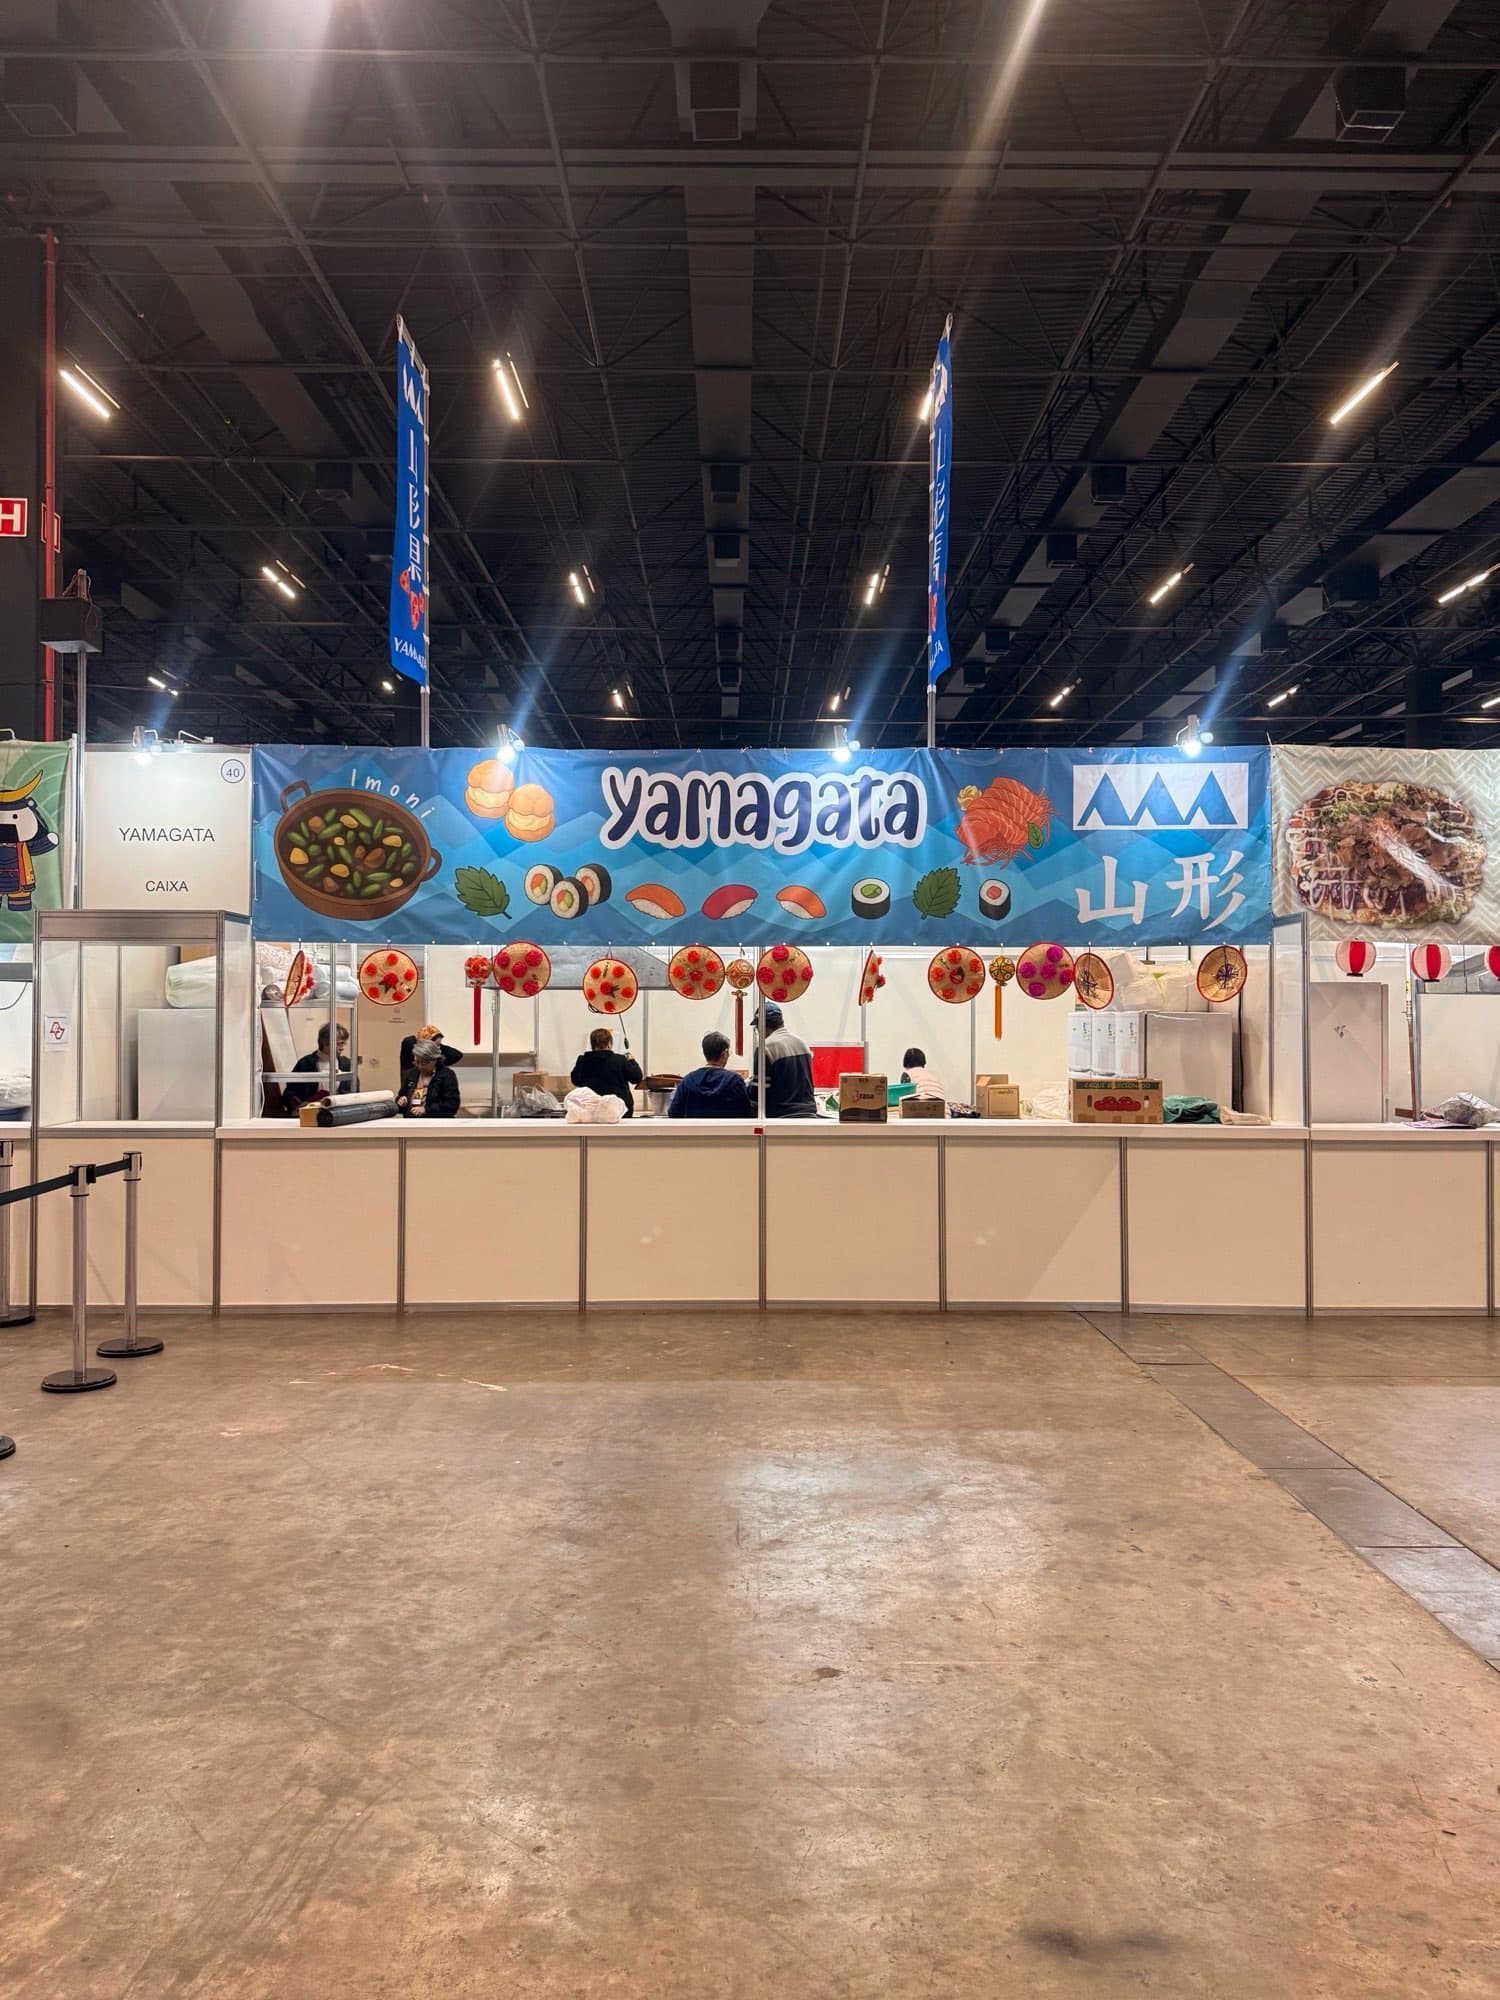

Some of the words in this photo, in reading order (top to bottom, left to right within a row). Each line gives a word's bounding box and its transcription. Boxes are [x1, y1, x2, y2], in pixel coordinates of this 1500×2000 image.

[226, 768, 240, 778] 40
[351, 768, 435, 818] Imoni
[606, 773, 920, 849] yamagata
[119, 827, 215, 842] YAMAGATA
[145, 880, 189, 892] CAIXA
[1075, 850, 1246, 932] 山形
